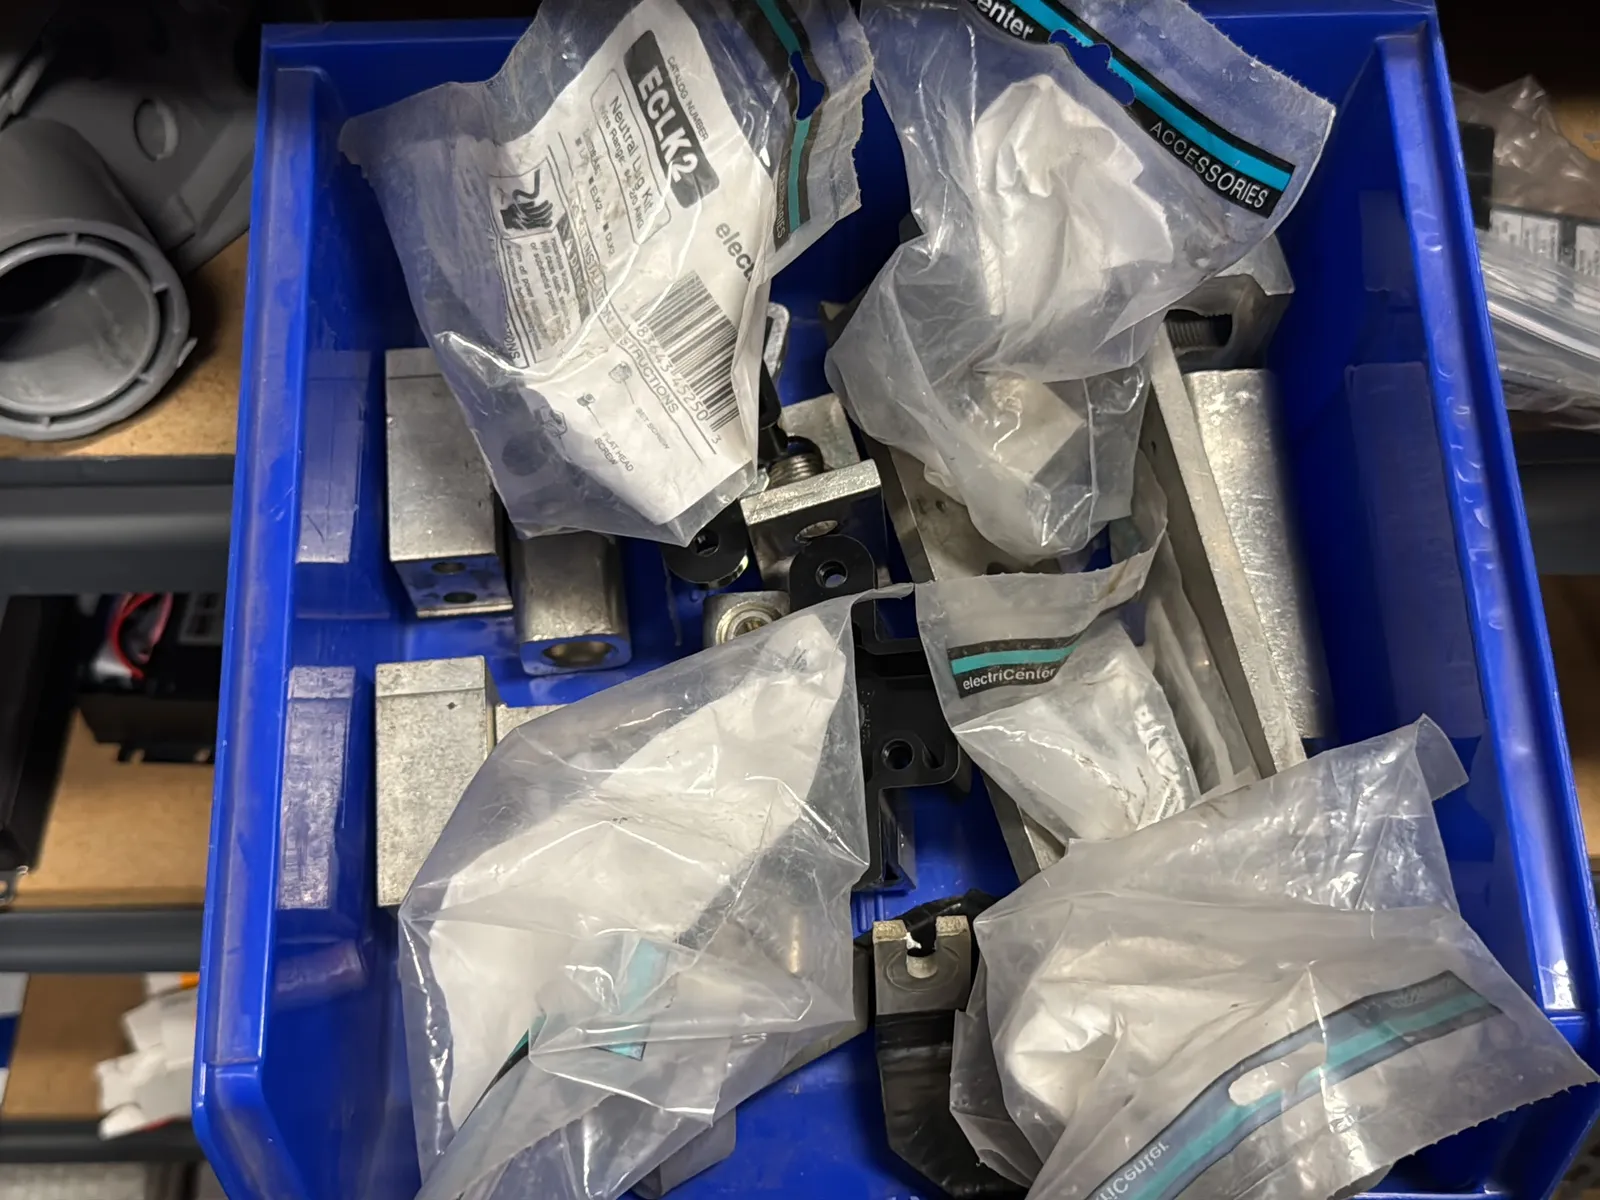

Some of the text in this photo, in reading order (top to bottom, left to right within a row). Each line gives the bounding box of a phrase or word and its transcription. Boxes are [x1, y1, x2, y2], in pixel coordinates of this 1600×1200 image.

[637, 67, 698, 183] ECLK2
[667, 56, 708, 141] CATALOG NUMBER
[609, 95, 654, 214] Neutral Lug Kit
[1150, 120, 1269, 209] ACCESSORIES
[716, 223, 755, 282] elect
[636, 325, 673, 373] 83643
[672, 377, 709, 421] 45250
[593, 437, 619, 466] SCREW
[962, 667, 1056, 690] electriCenter
